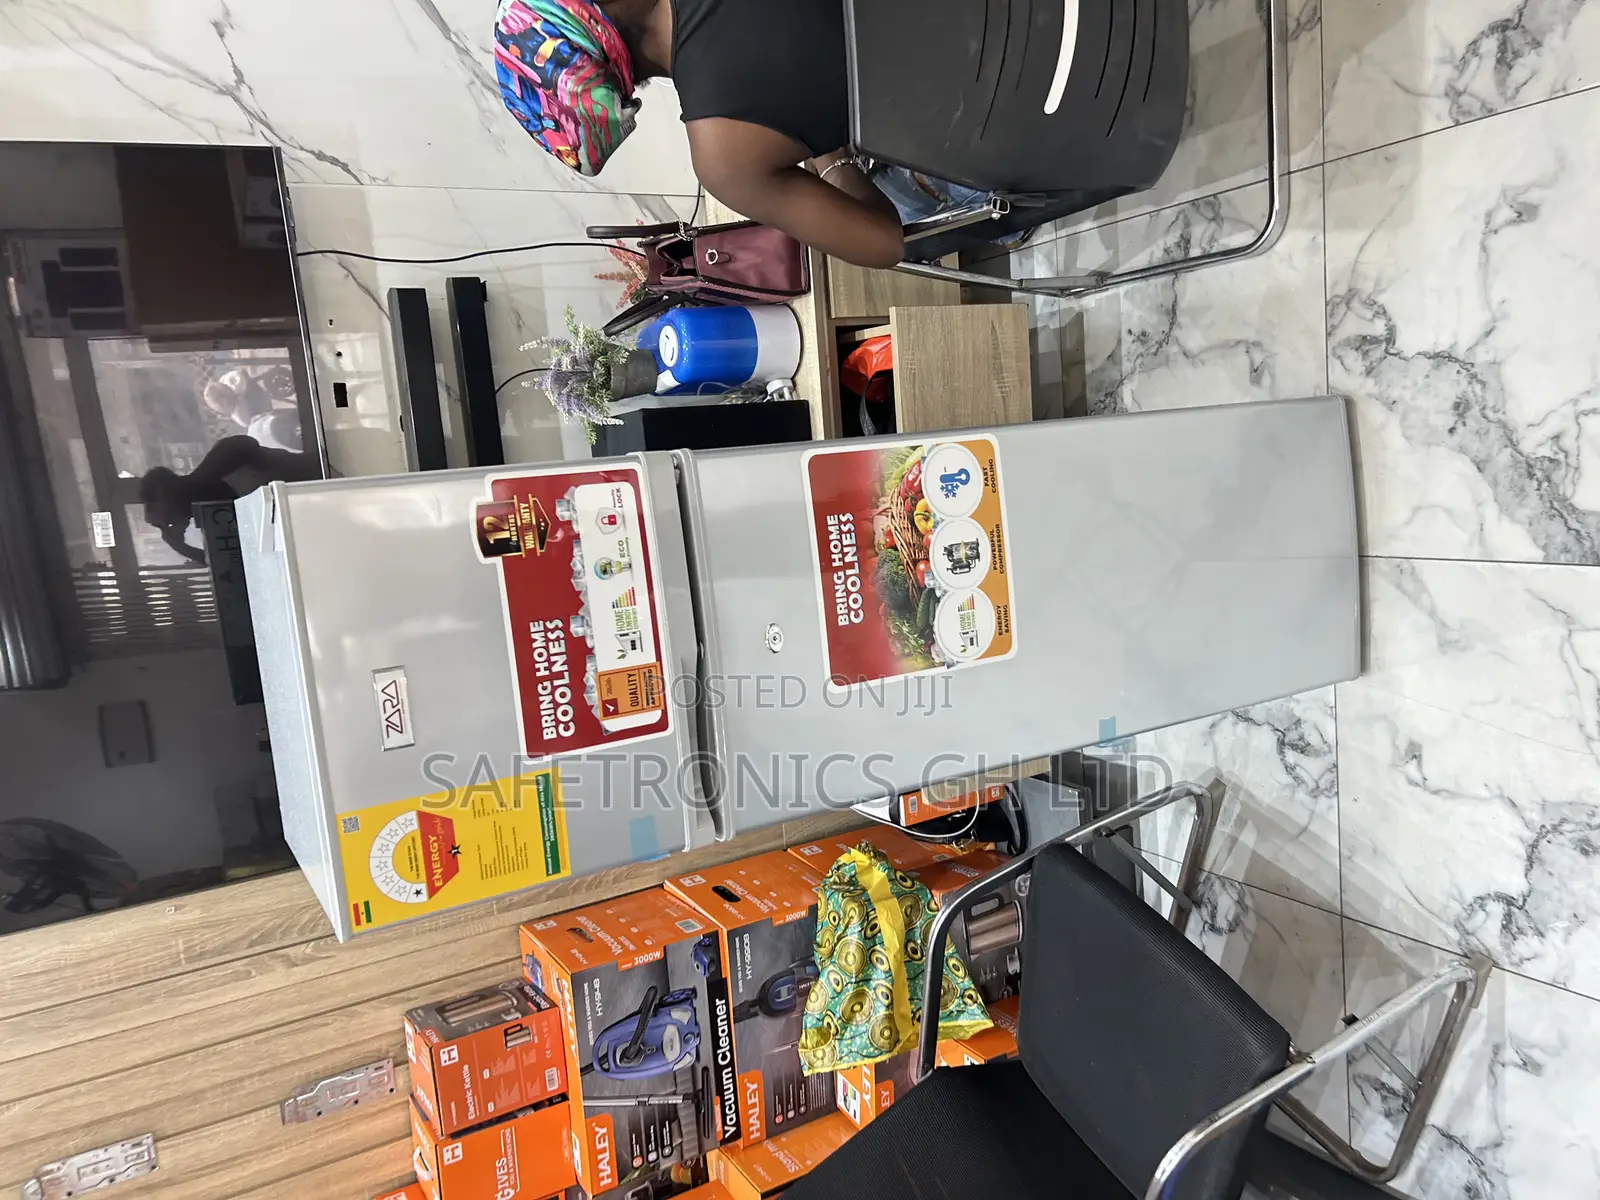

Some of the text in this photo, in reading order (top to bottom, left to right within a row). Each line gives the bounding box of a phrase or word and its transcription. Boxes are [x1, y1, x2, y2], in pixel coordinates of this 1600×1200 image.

[982, 466, 990, 487] FAST
[988, 458, 997, 494] COOLING
[616, 488, 624, 508] LOCK
[483, 516, 510, 544] 12
[508, 514, 518, 541] MONTHS
[520, 503, 535, 549] WAANTY
[618, 540, 626, 558] ECO
[840, 512, 864, 624] COOLNESS
[990, 528, 998, 570] POWERFUL
[996, 524, 1004, 574] COMPRESSOR
[827, 514, 850, 626] BRING HOME
[614, 610, 626, 632] HOME
[624, 608, 634, 631] ENERGY
[530, 620, 557, 740] BRING HOME
[546, 619, 575, 737] COOLNESS
[627, 673, 640, 707] QUALITY
[648, 668, 656, 705] APPROVED
[381, 680, 403, 739] ZARA
[428, 835, 444, 886] ENERGY
[745, 893, 770, 913] Vacuum
[575, 915, 601, 932] Cleaner
[597, 930, 624, 955] Vacuum
[634, 950, 660, 964] 3000W
[716, 998, 737, 1138] Vacuum Cleaner
[462, 1064, 476, 1120] Electric Kettle
[746, 1082, 761, 1139] HALEY
[594, 1126, 612, 1186] HALEY
[495, 1156, 515, 1200] GIVES
